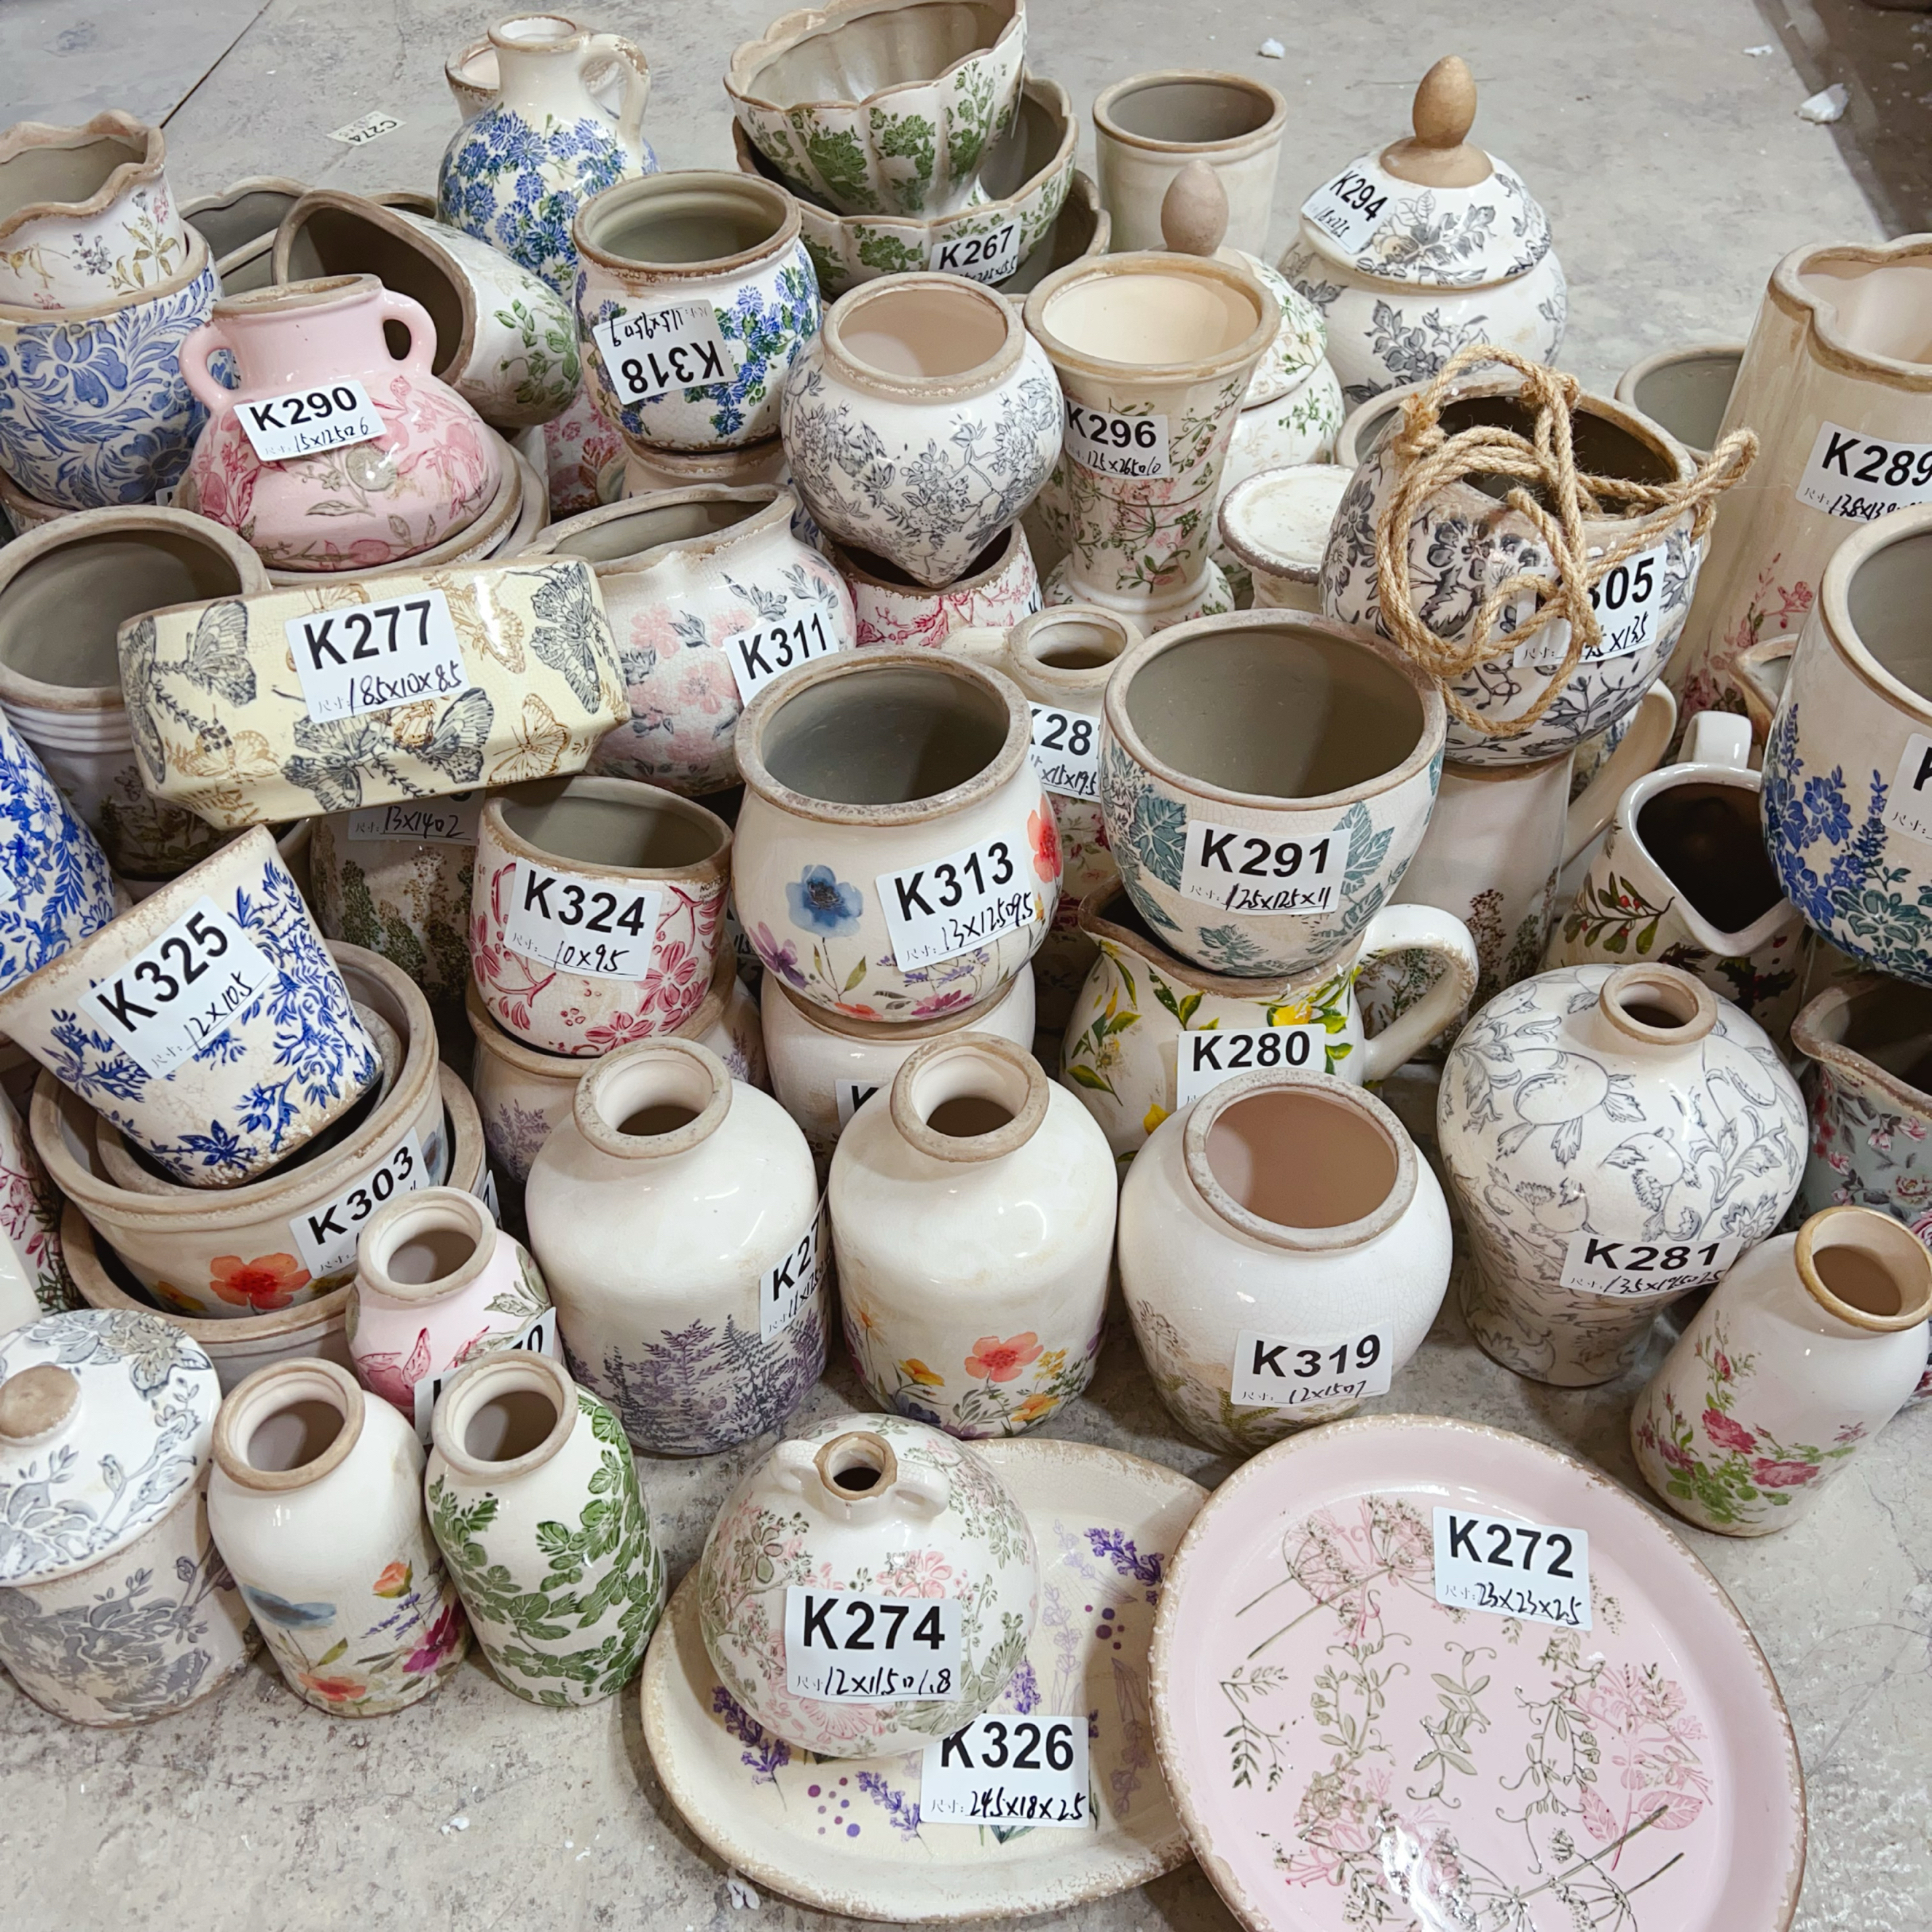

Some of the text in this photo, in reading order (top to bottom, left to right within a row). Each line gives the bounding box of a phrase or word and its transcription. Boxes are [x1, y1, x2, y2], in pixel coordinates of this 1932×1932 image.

[1329, 170, 1388, 221] K294
[938, 225, 1014, 270] K267
[622, 341, 725, 394] K318
[249, 387, 357, 431] K290
[1066, 400, 1157, 448] K296
[1822, 431, 1932, 487] K289
[303, 599, 431, 670] K277
[738, 612, 827, 680] K311
[1201, 829, 1330, 877] K291
[524, 869, 645, 937] K324
[895, 842, 1014, 921] K313
[96, 911, 229, 1033] K325
[1193, 1031, 1310, 1072] K280
[307, 1146, 414, 1245] K303
[773, 1208, 824, 1302] K27
[1584, 1238, 1720, 1272] K281
[1253, 1334, 1381, 1378] K319
[1449, 1515, 1574, 1579] K272
[804, 1595, 945, 1649] K274
[941, 1721, 1074, 1771] K326
